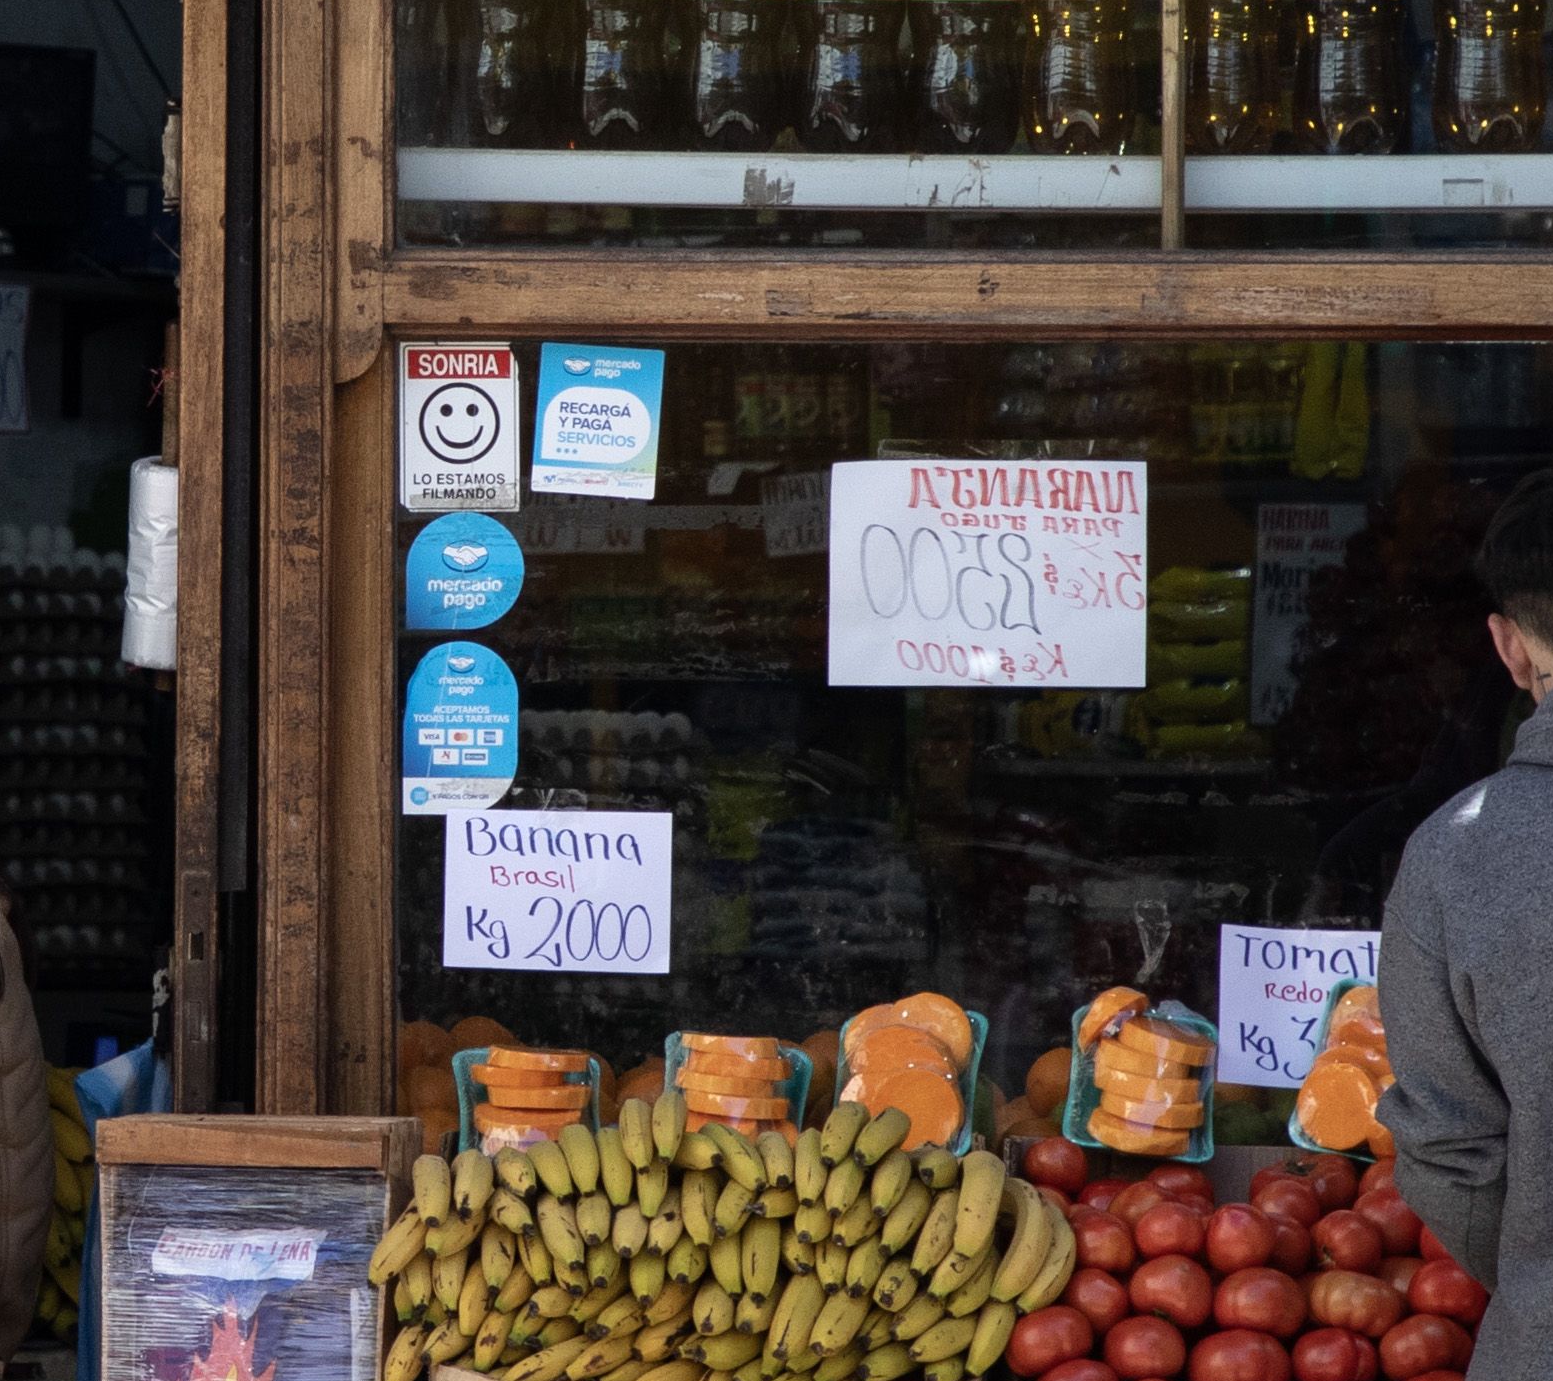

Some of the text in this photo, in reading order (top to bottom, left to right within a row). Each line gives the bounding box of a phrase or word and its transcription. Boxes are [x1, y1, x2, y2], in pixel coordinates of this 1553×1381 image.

[417, 352, 500, 377] SONRIA
[595, 358, 642, 371] mercado
[594, 367, 621, 379] pago
[559, 400, 632, 419] RECARGÁ
[558, 415, 613, 433] Y PAGÁ
[556, 431, 636, 449] SERVICIOS
[413, 474, 506, 486] LO ESTAMOS
[421, 487, 497, 500] FILMANDO
[427, 577, 503, 593] mercado
[443, 591, 487, 609] pago
[438, 675, 485, 687] mercado
[448, 684, 475, 696] pago
[433, 704, 491, 715] ACEPTAMOS
[413, 713, 510, 725] TODAS LAS TARJETAS
[465, 819, 644, 865] Banana
[489, 865, 576, 894] Brasil
[524, 896, 653, 967] 2000
